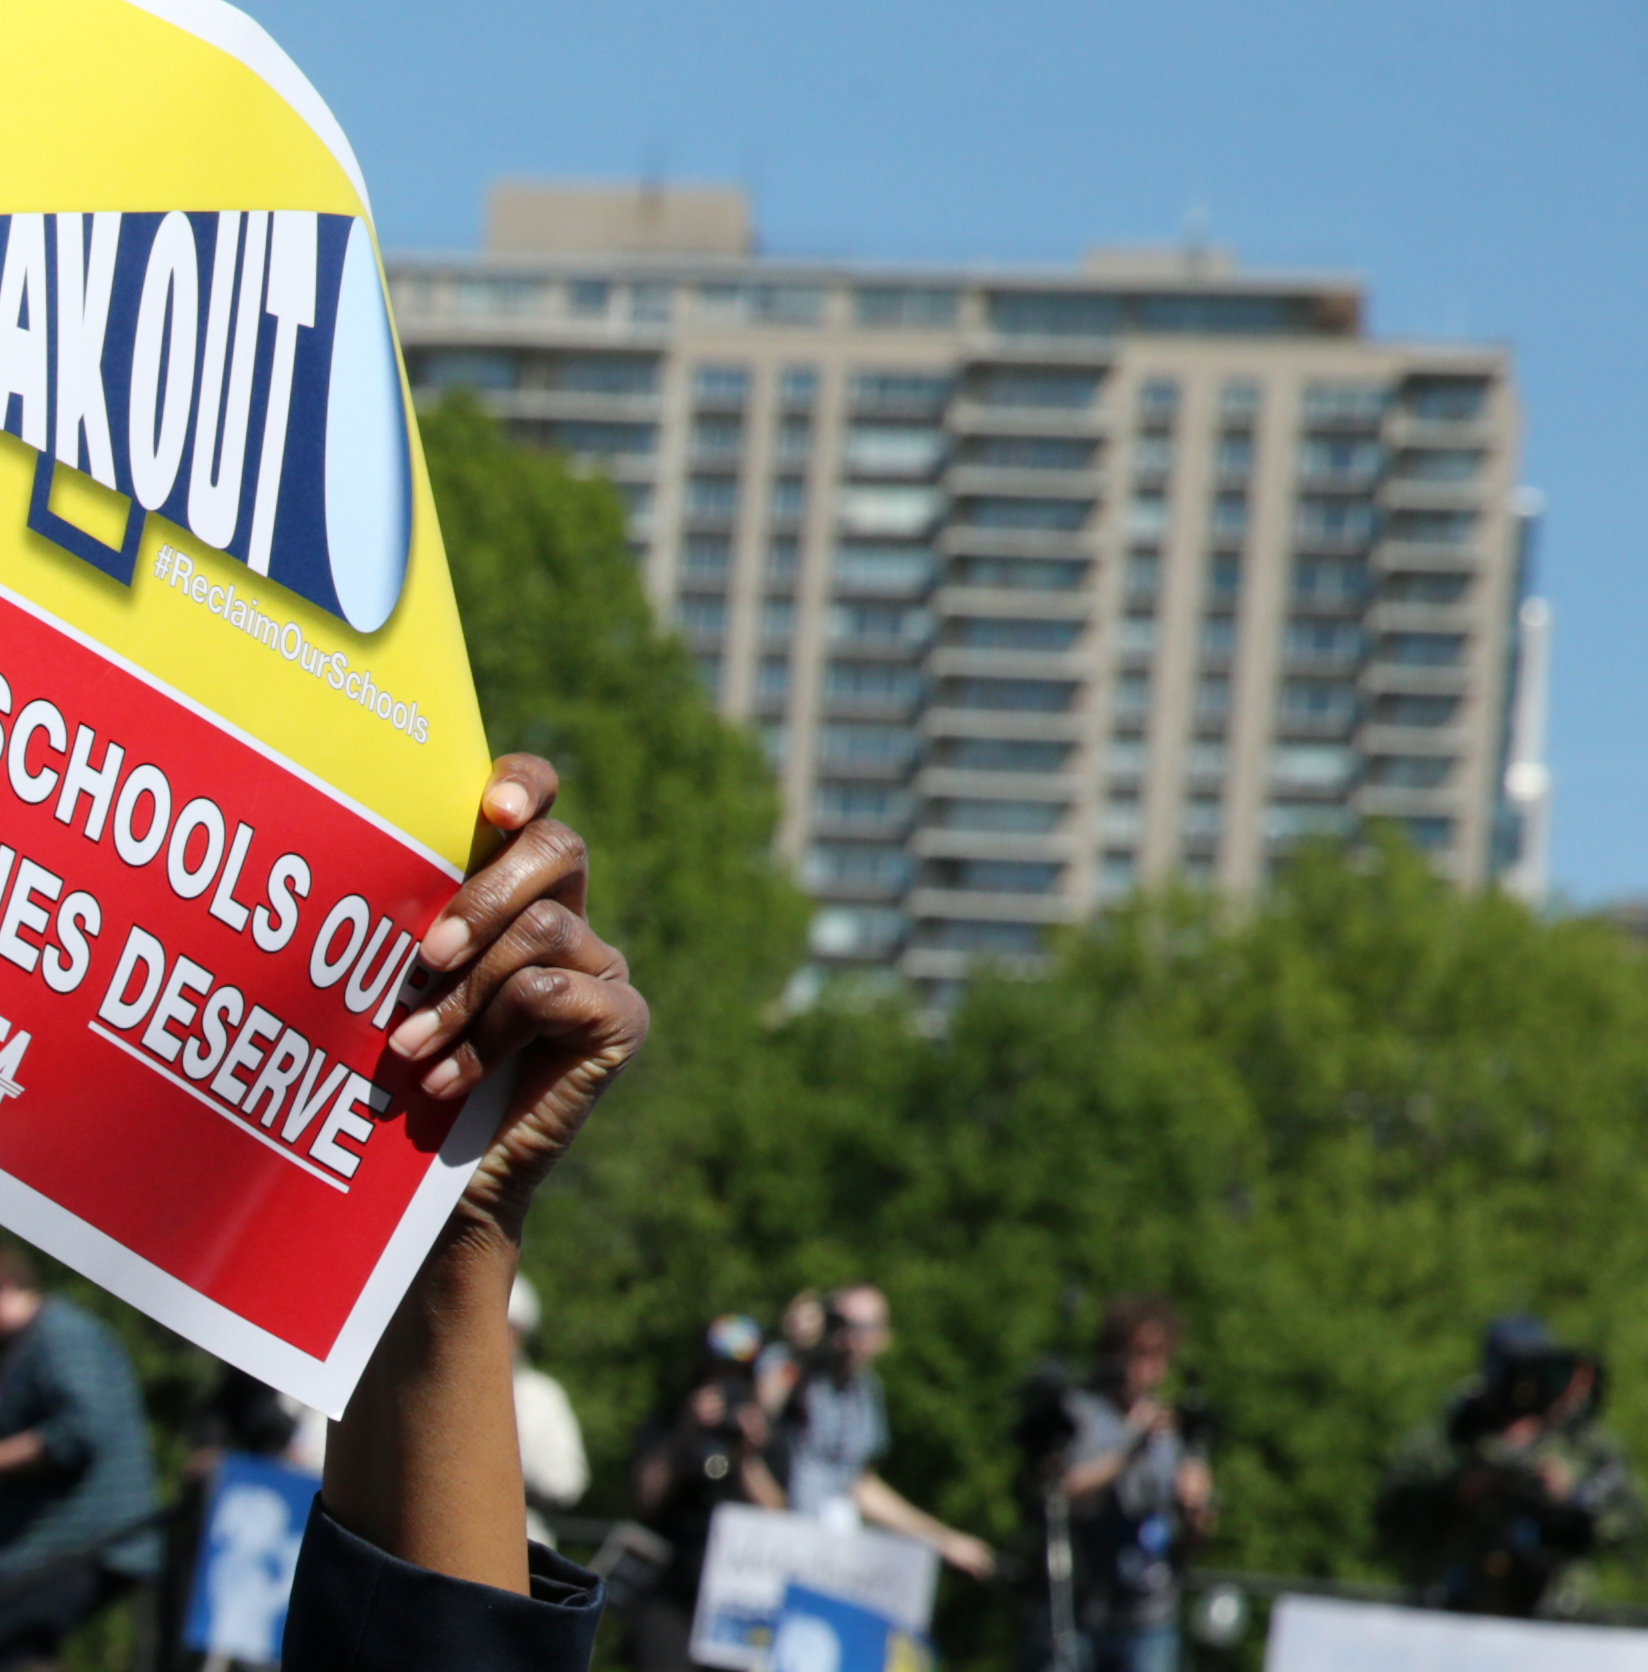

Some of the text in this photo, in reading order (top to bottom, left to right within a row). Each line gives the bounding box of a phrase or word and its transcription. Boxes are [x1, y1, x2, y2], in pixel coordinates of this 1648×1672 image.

[129, 210, 318, 577] OUT
[153, 544, 430, 744] #ReclaimOurSchools
[97, 923, 394, 1180] DESERVE
